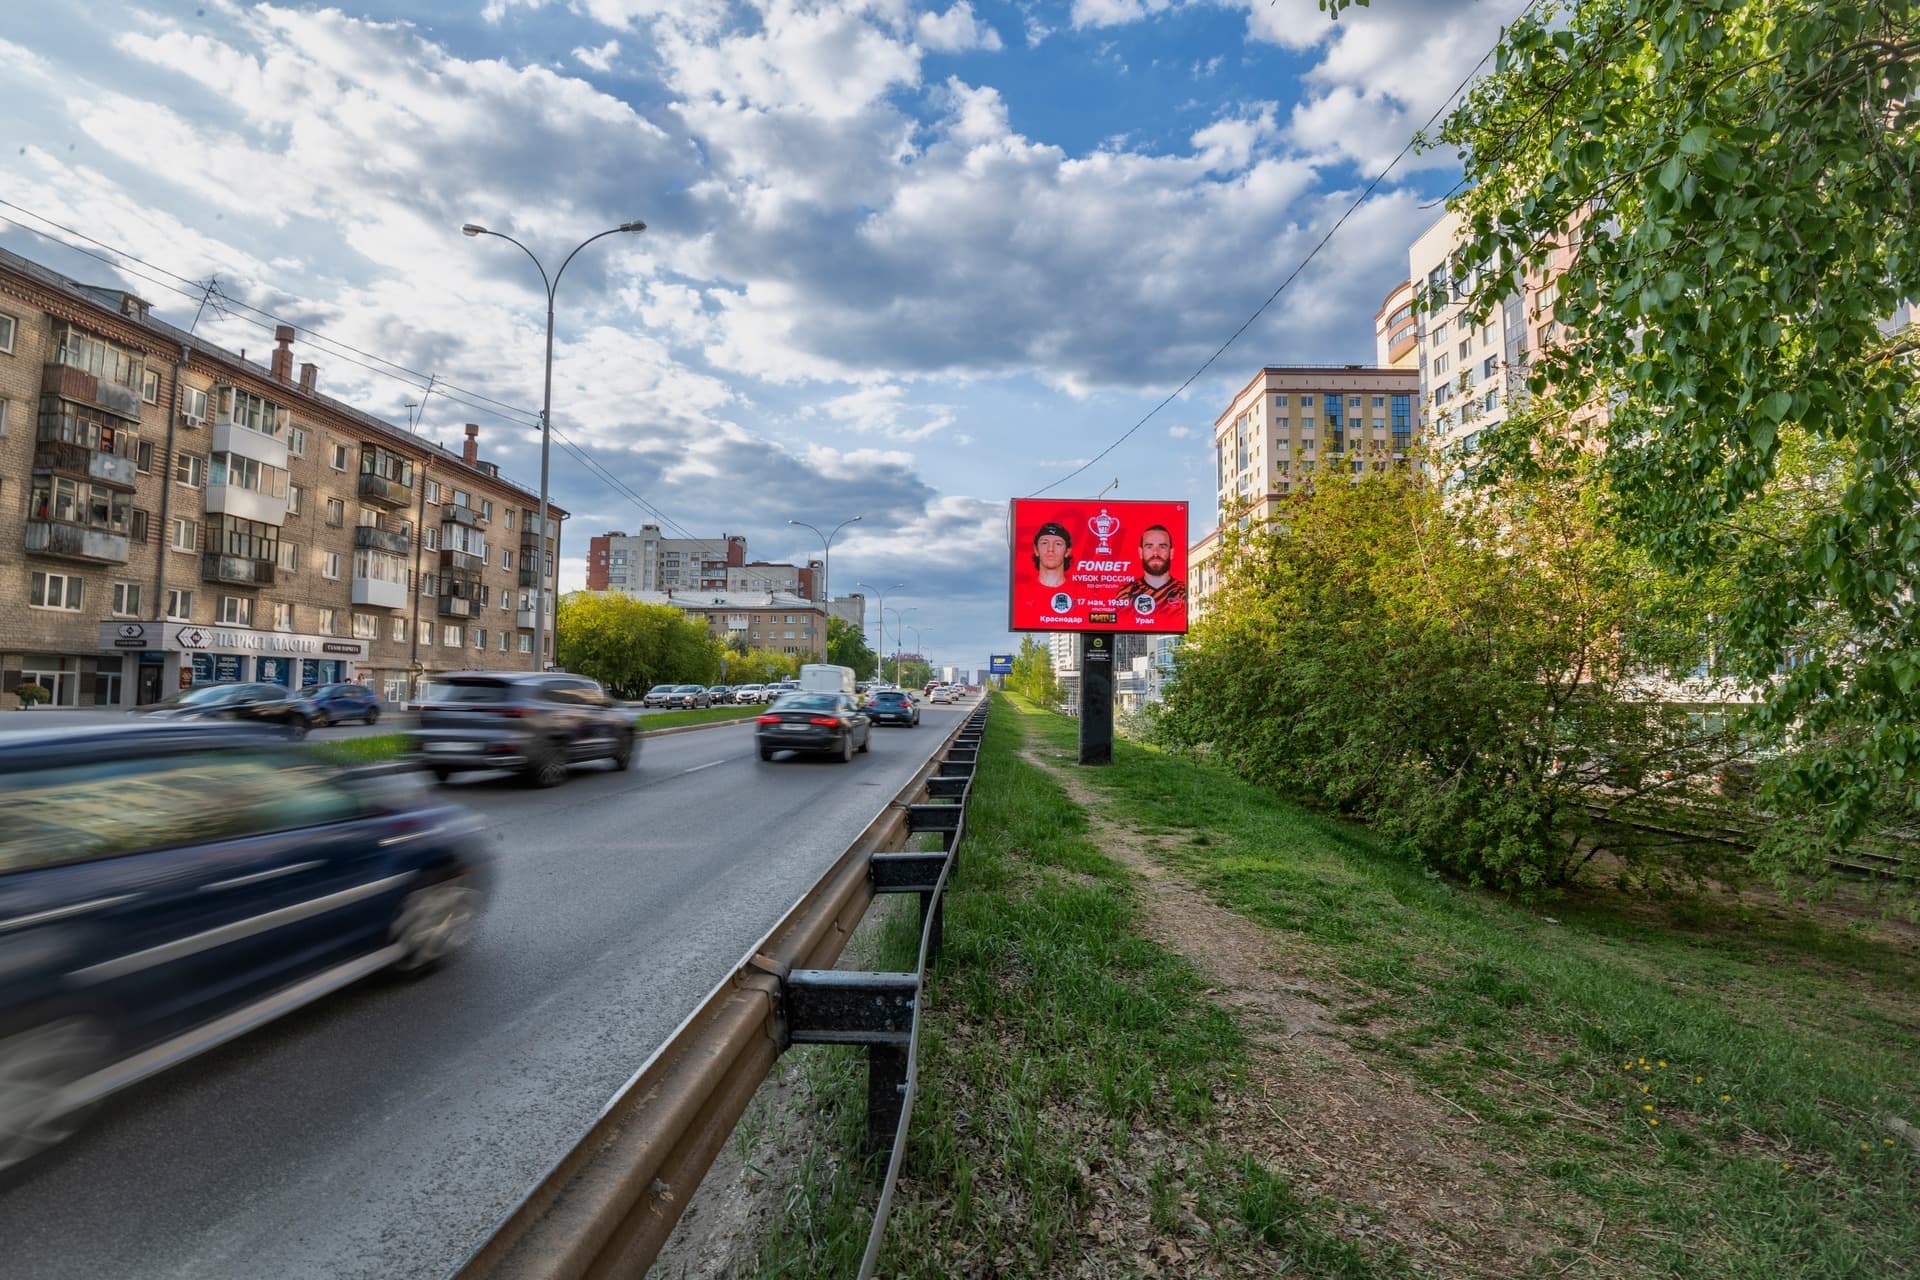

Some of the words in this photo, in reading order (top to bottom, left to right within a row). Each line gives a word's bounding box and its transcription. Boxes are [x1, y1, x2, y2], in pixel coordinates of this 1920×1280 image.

[1077, 560, 1131, 572] FONBET
[1072, 574, 1099, 582] КУБОК
[1040, 615, 1083, 624] Краснодар
[217, 632, 266, 650] ПАРКЕТ
[271, 637, 317, 653] МАСТЕР
